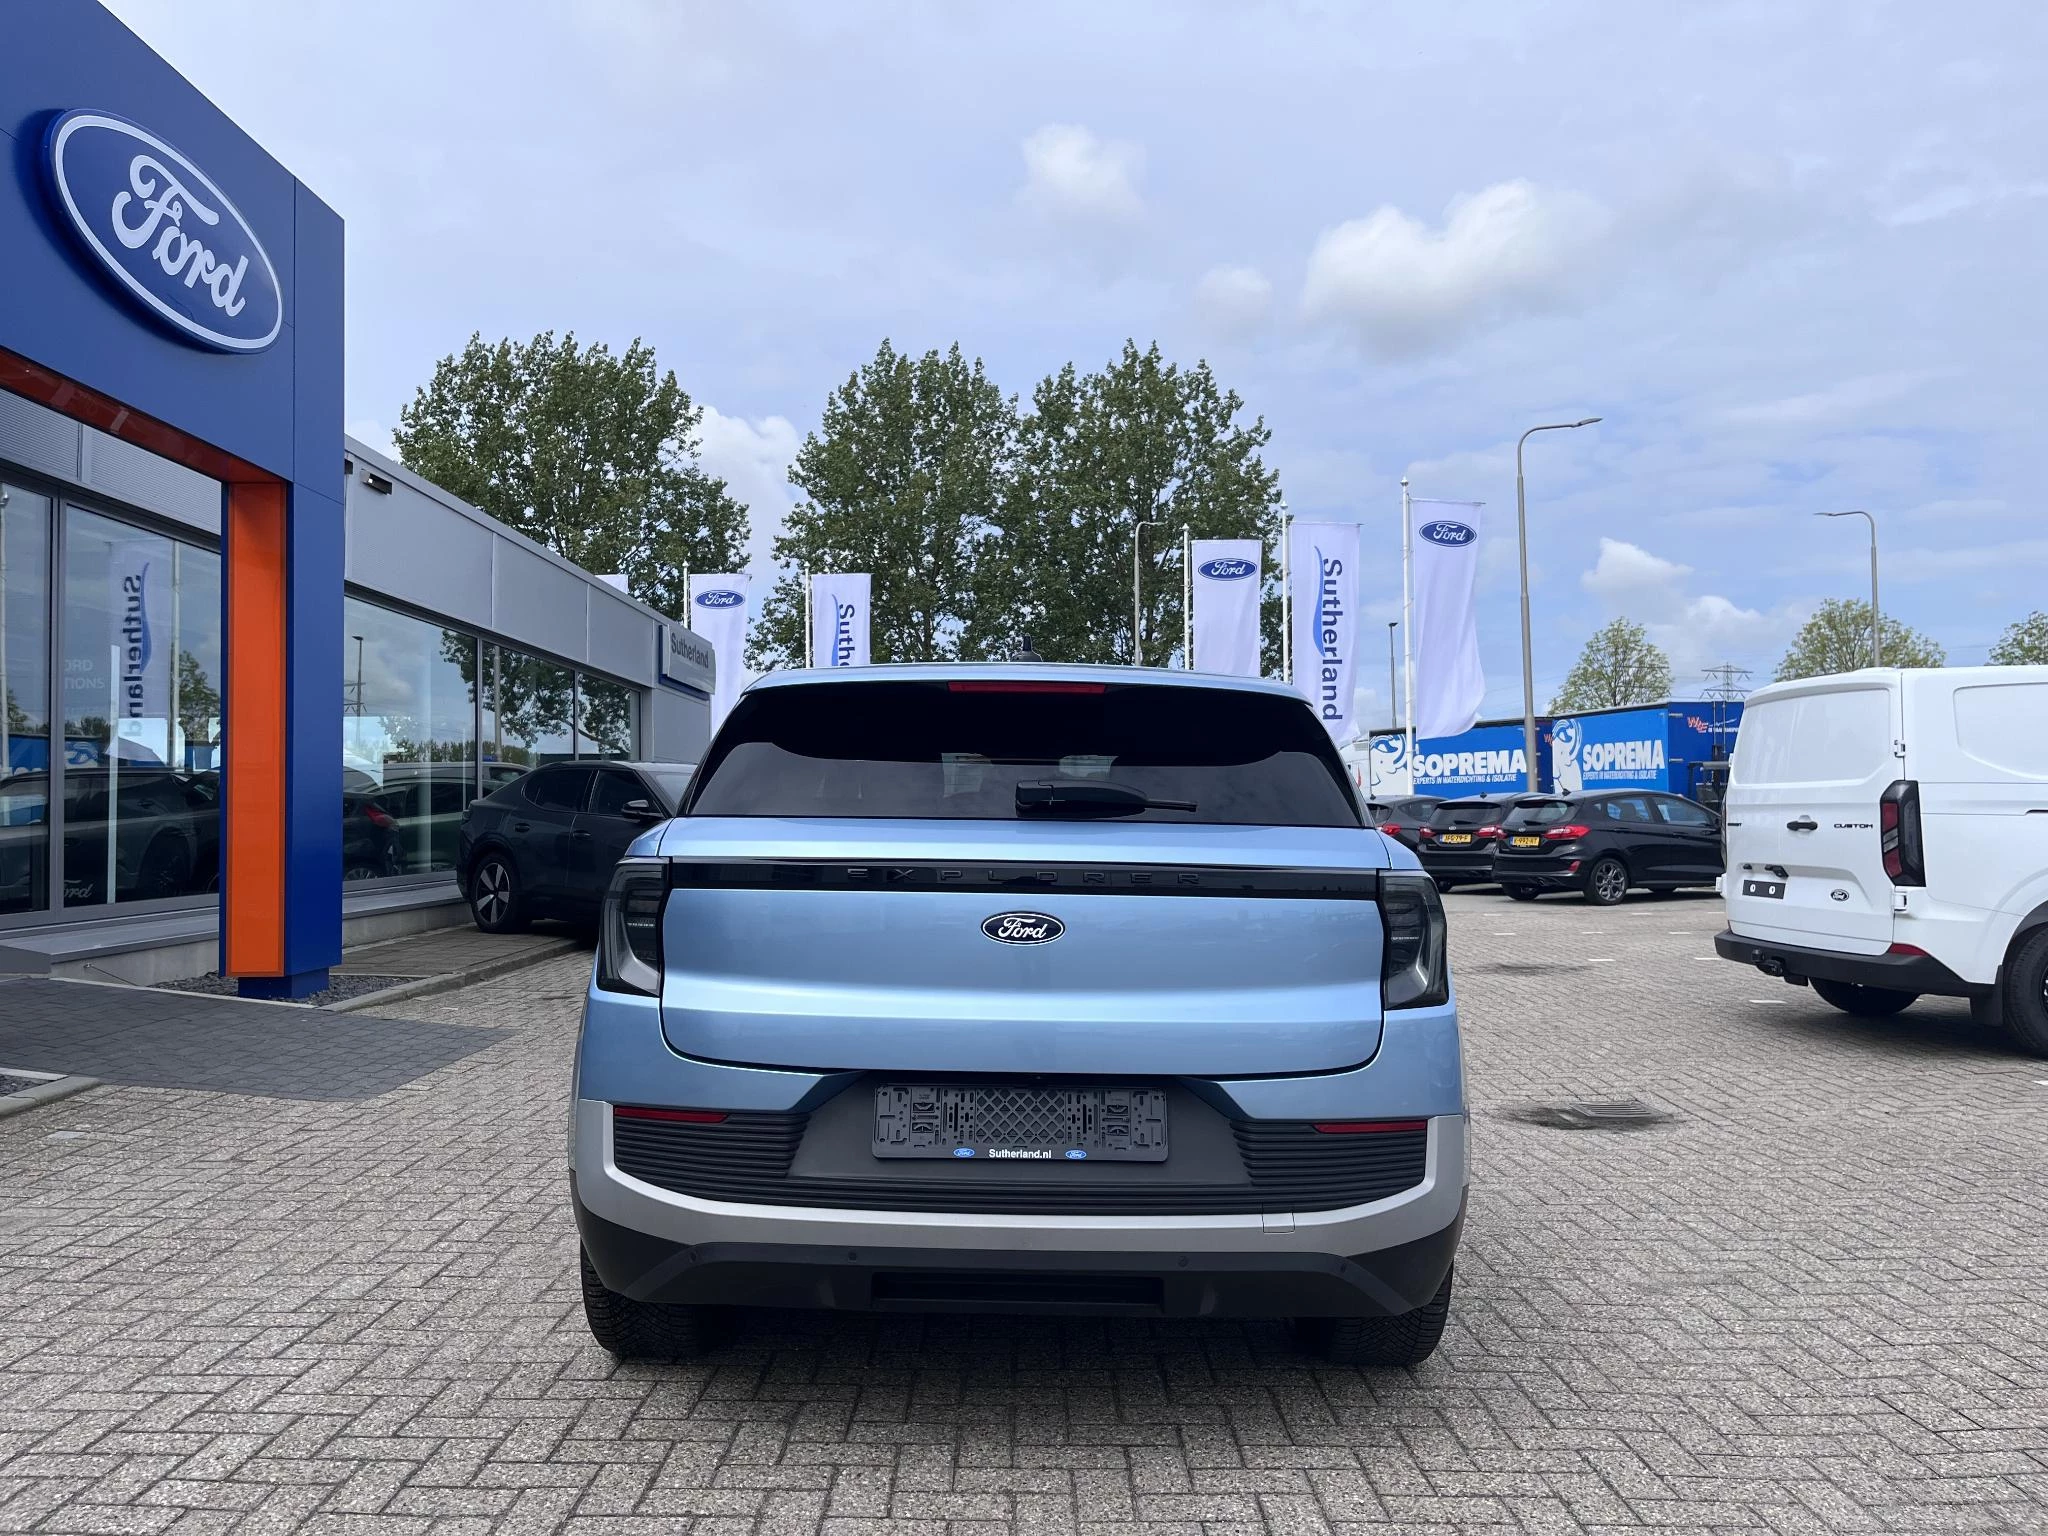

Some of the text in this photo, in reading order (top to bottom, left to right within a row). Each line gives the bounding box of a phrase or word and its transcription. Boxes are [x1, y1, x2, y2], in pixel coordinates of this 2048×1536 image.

[111, 154, 247, 318] Ford
[1433, 522, 1466, 542] Ford
[1211, 560, 1246, 576] Ford
[705, 592, 735, 605] Ford
[671, 632, 709, 669] Sutherland
[1322, 558, 1344, 720] Sutherland
[1413, 749, 1527, 778] SOPREMA
[1582, 740, 1666, 772] SOPREMA
[848, 868, 1200, 885] EXPLORER
[998, 916, 1047, 939] Ford
[988, 1149, 1052, 1159] Sutherland.nl
